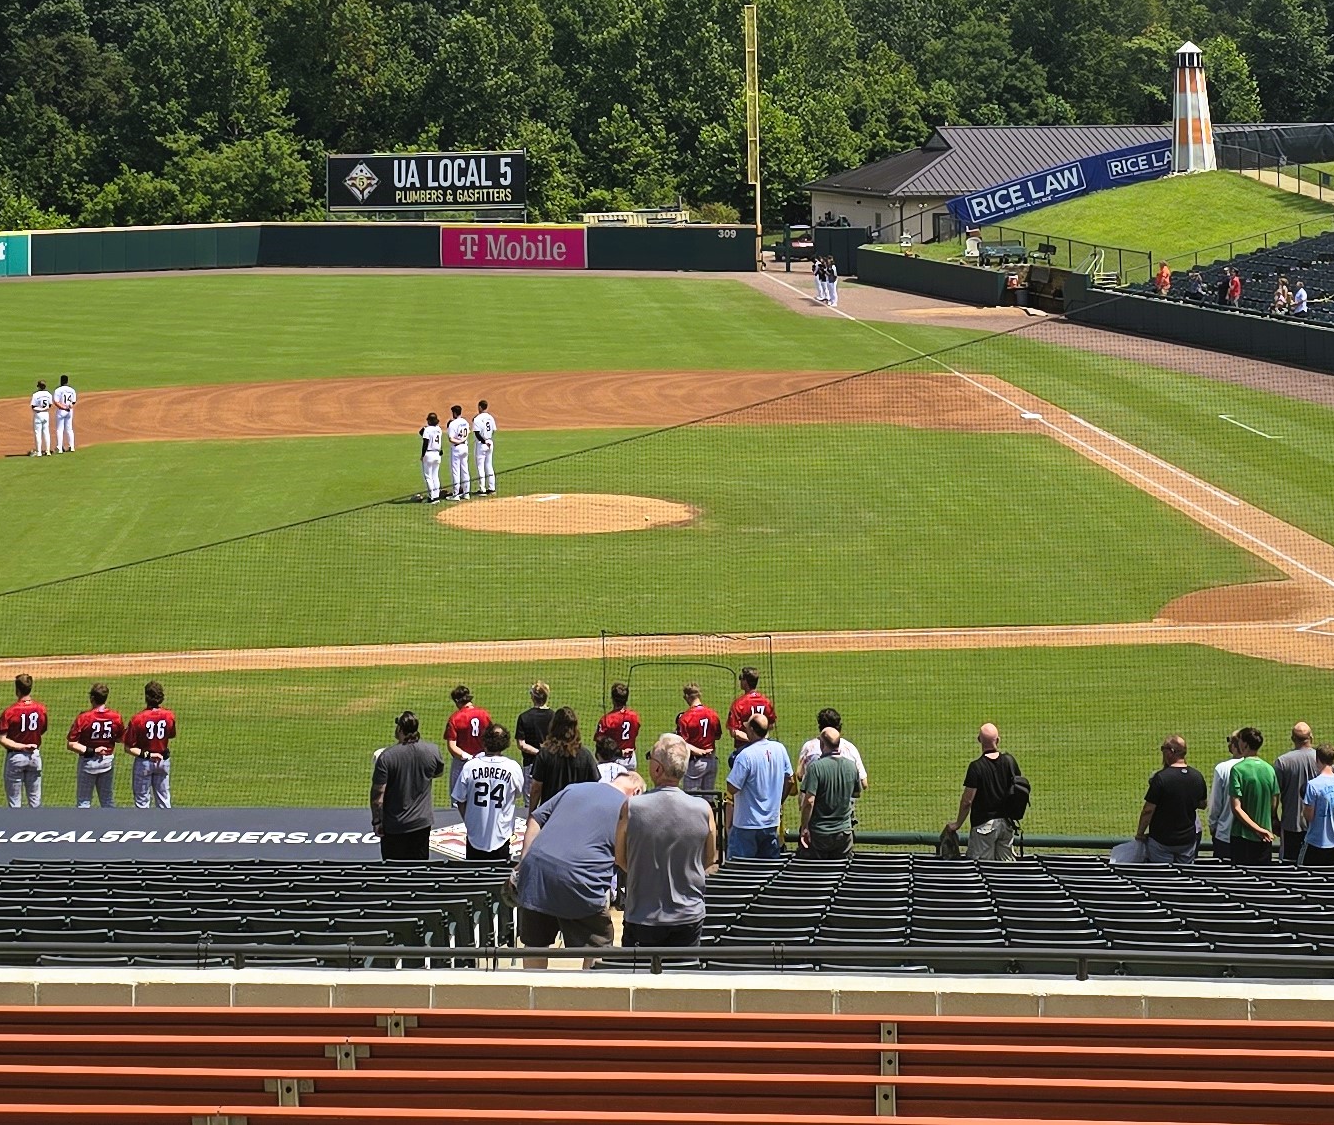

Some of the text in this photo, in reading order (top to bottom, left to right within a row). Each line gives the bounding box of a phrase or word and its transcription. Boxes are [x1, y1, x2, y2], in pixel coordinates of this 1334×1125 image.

[393, 157, 512, 187] UA LOCAL 5
[1110, 156, 1149, 175] RICE
[1151, 150, 1173, 166] LA
[395, 189, 512, 203] PLUMBERS & GASFITTERS
[971, 167, 1079, 217] RICE LAW
[717, 229, 737, 239] 309
[459, 234, 567, 261] T Mobile
[42, 399, 48, 408] 5
[20, 712, 39, 732] 18
[90, 721, 113, 740] 25
[145, 720, 167, 740] 36
[470, 717, 480, 737] 8
[621, 721, 630, 740] 2
[699, 717, 709, 738] 7
[471, 766, 512, 783] CABRERA
[474, 782, 505, 808] 24
